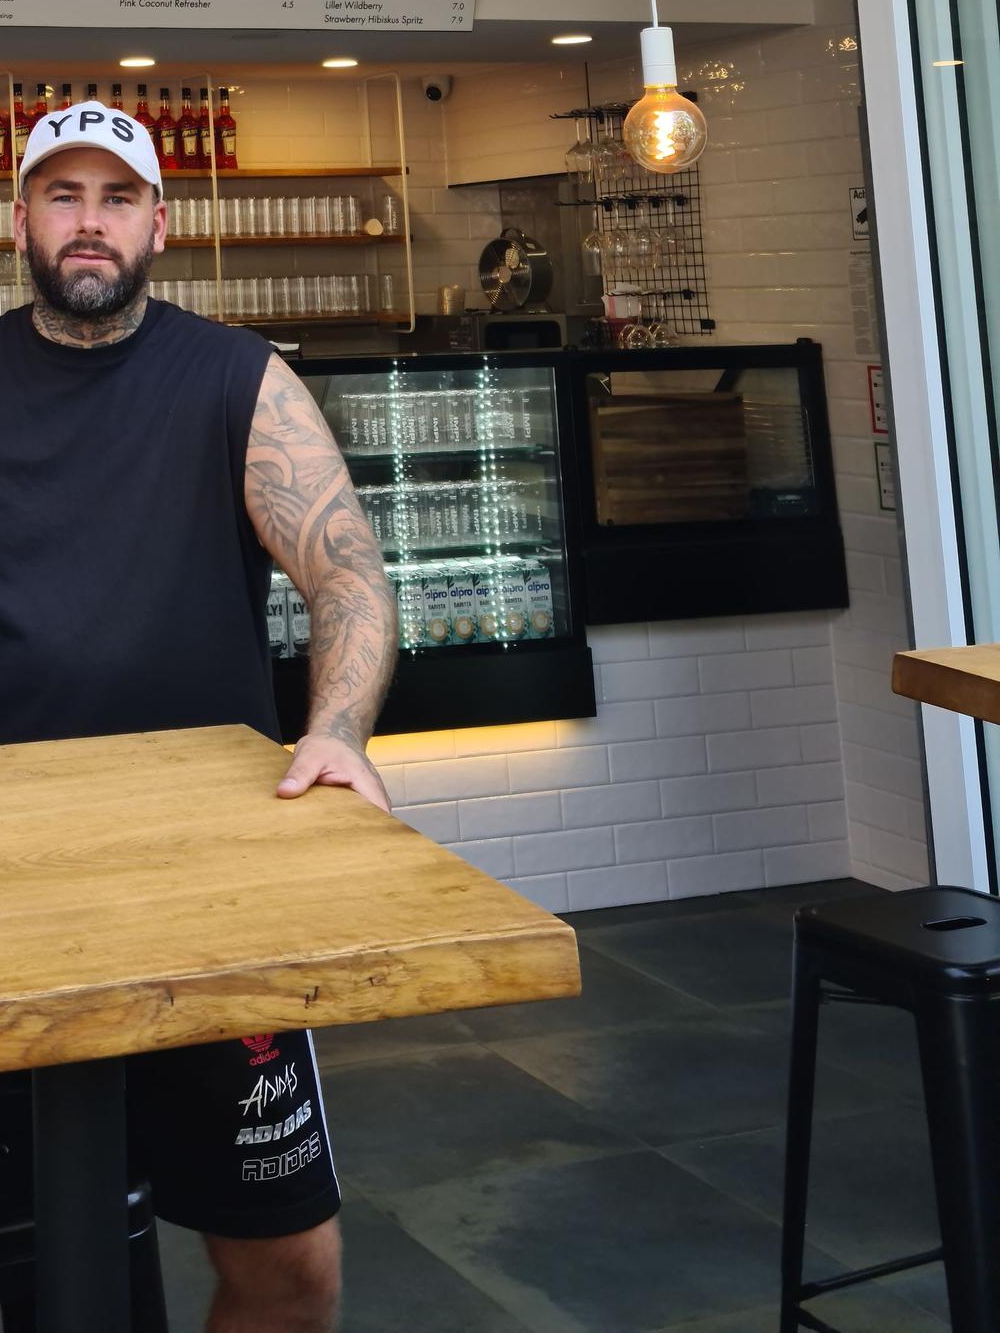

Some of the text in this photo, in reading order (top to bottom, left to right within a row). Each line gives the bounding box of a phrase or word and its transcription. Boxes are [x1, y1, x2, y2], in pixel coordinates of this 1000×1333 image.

[139, 0, 172, 8] Coconut
[175, 0, 210, 8] Refresher
[326, 1, 382, 12] Lillet Wildberry
[324, 15, 423, 25] Strawberry Hibiskus Spritz
[48, 111, 134, 142] YPS
[528, 582, 549, 592] alpro
[425, 590, 447, 601] alpro
[451, 588, 472, 599] alpro
[250, 1048, 280, 1066] adidas
[235, 1099, 312, 1145] ADIDAS
[242, 1131, 321, 1181] ADIDAS
